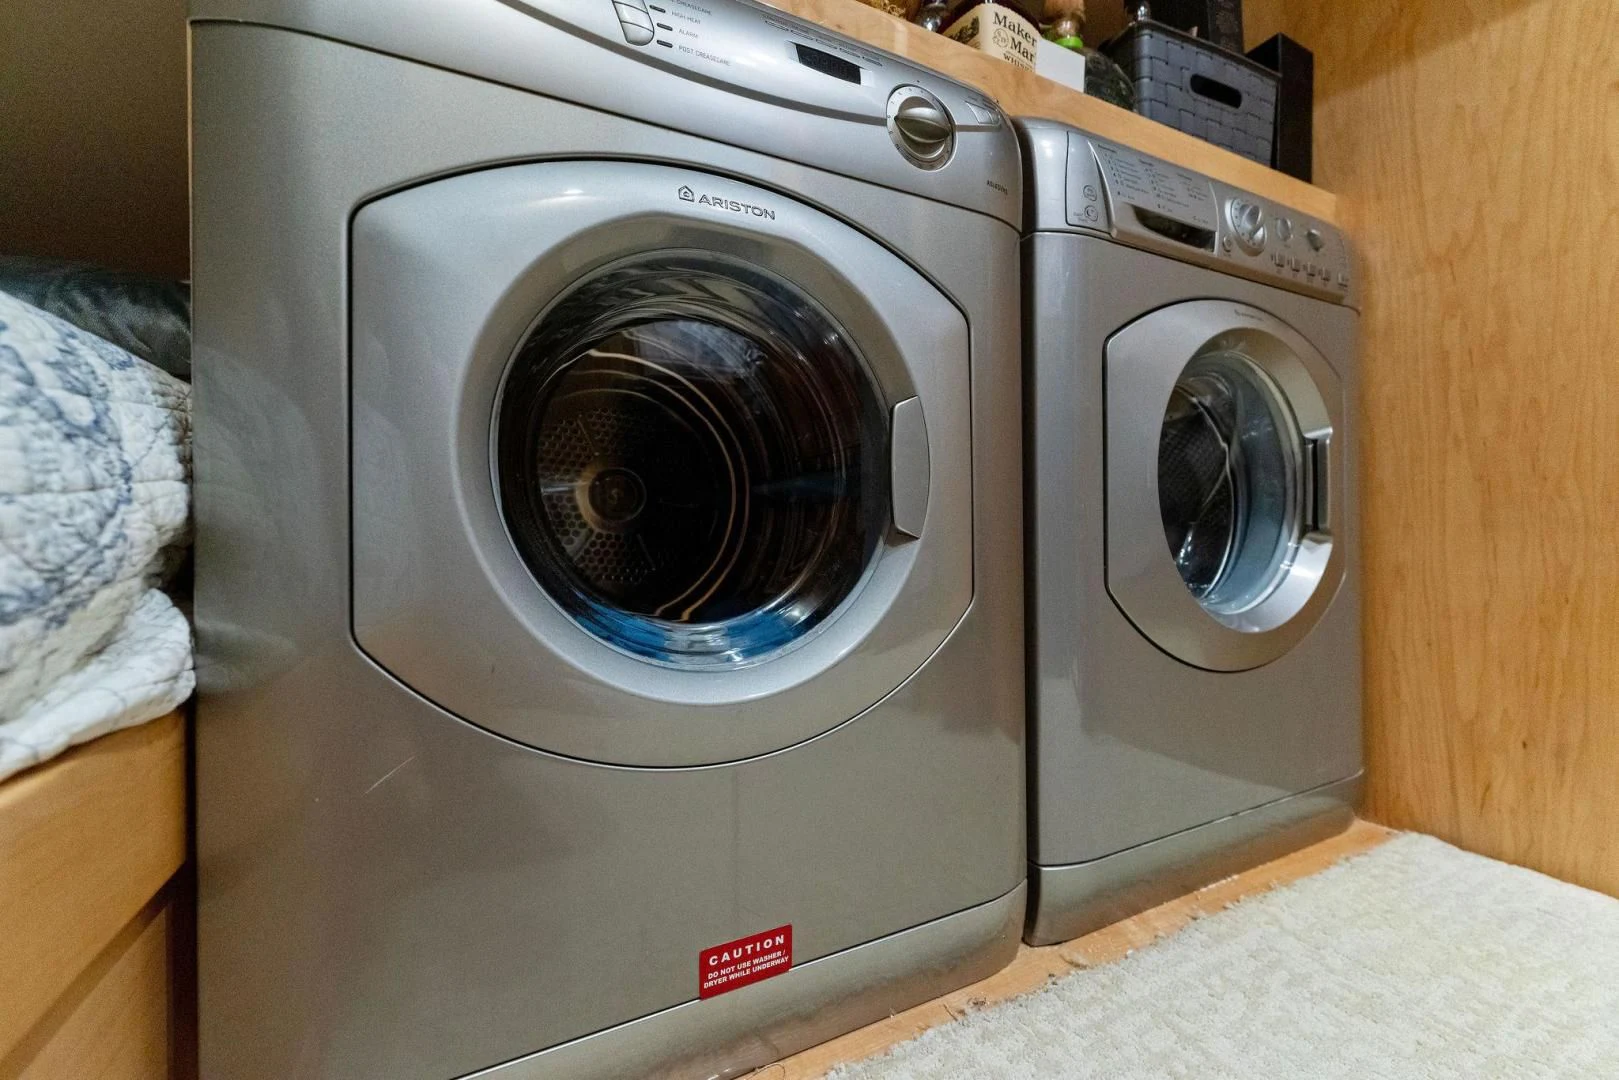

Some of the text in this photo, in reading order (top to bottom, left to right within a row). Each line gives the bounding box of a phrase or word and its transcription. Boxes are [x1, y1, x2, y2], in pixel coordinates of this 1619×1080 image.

[993, 11, 1037, 47] Maker
[1010, 36, 1035, 62] Mar
[699, 194, 776, 220] ARISTON
[708, 971, 719, 980] DO
[720, 965, 736, 976] NOT
[737, 960, 752, 970] USE
[752, 950, 782, 965] WASHER
[709, 934, 784, 966] CAUTION
[703, 956, 789, 989] DRYER WHILE UNDERWAY
